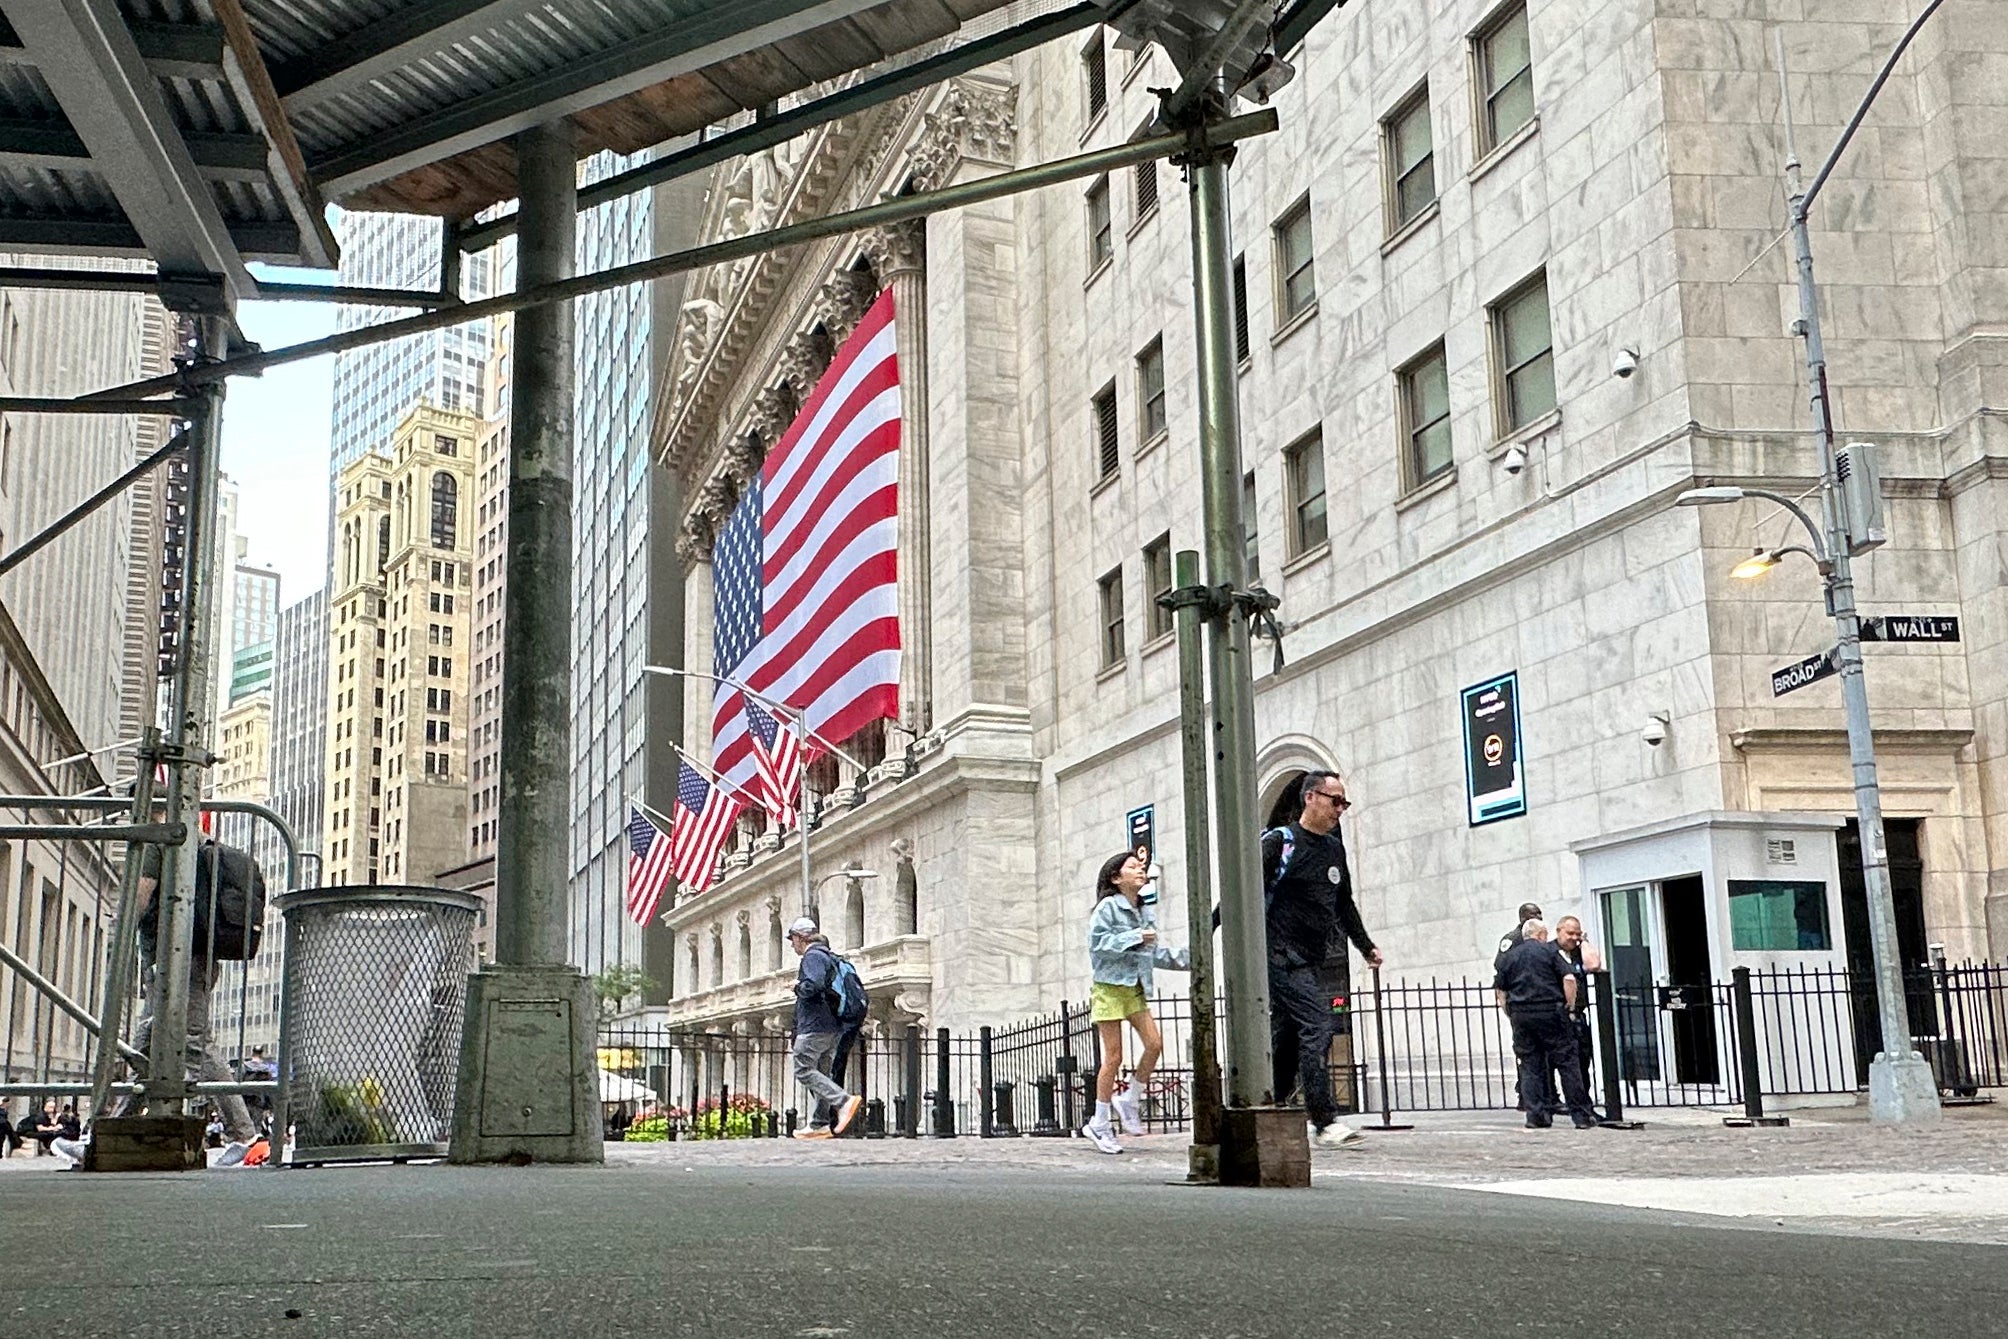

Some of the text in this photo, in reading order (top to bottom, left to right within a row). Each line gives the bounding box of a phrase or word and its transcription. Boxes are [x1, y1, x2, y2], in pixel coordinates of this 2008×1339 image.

[1892, 621, 1953, 638] WALL ST
[1774, 664, 1815, 693] BROAD
[1813, 660, 1821, 670] ST
